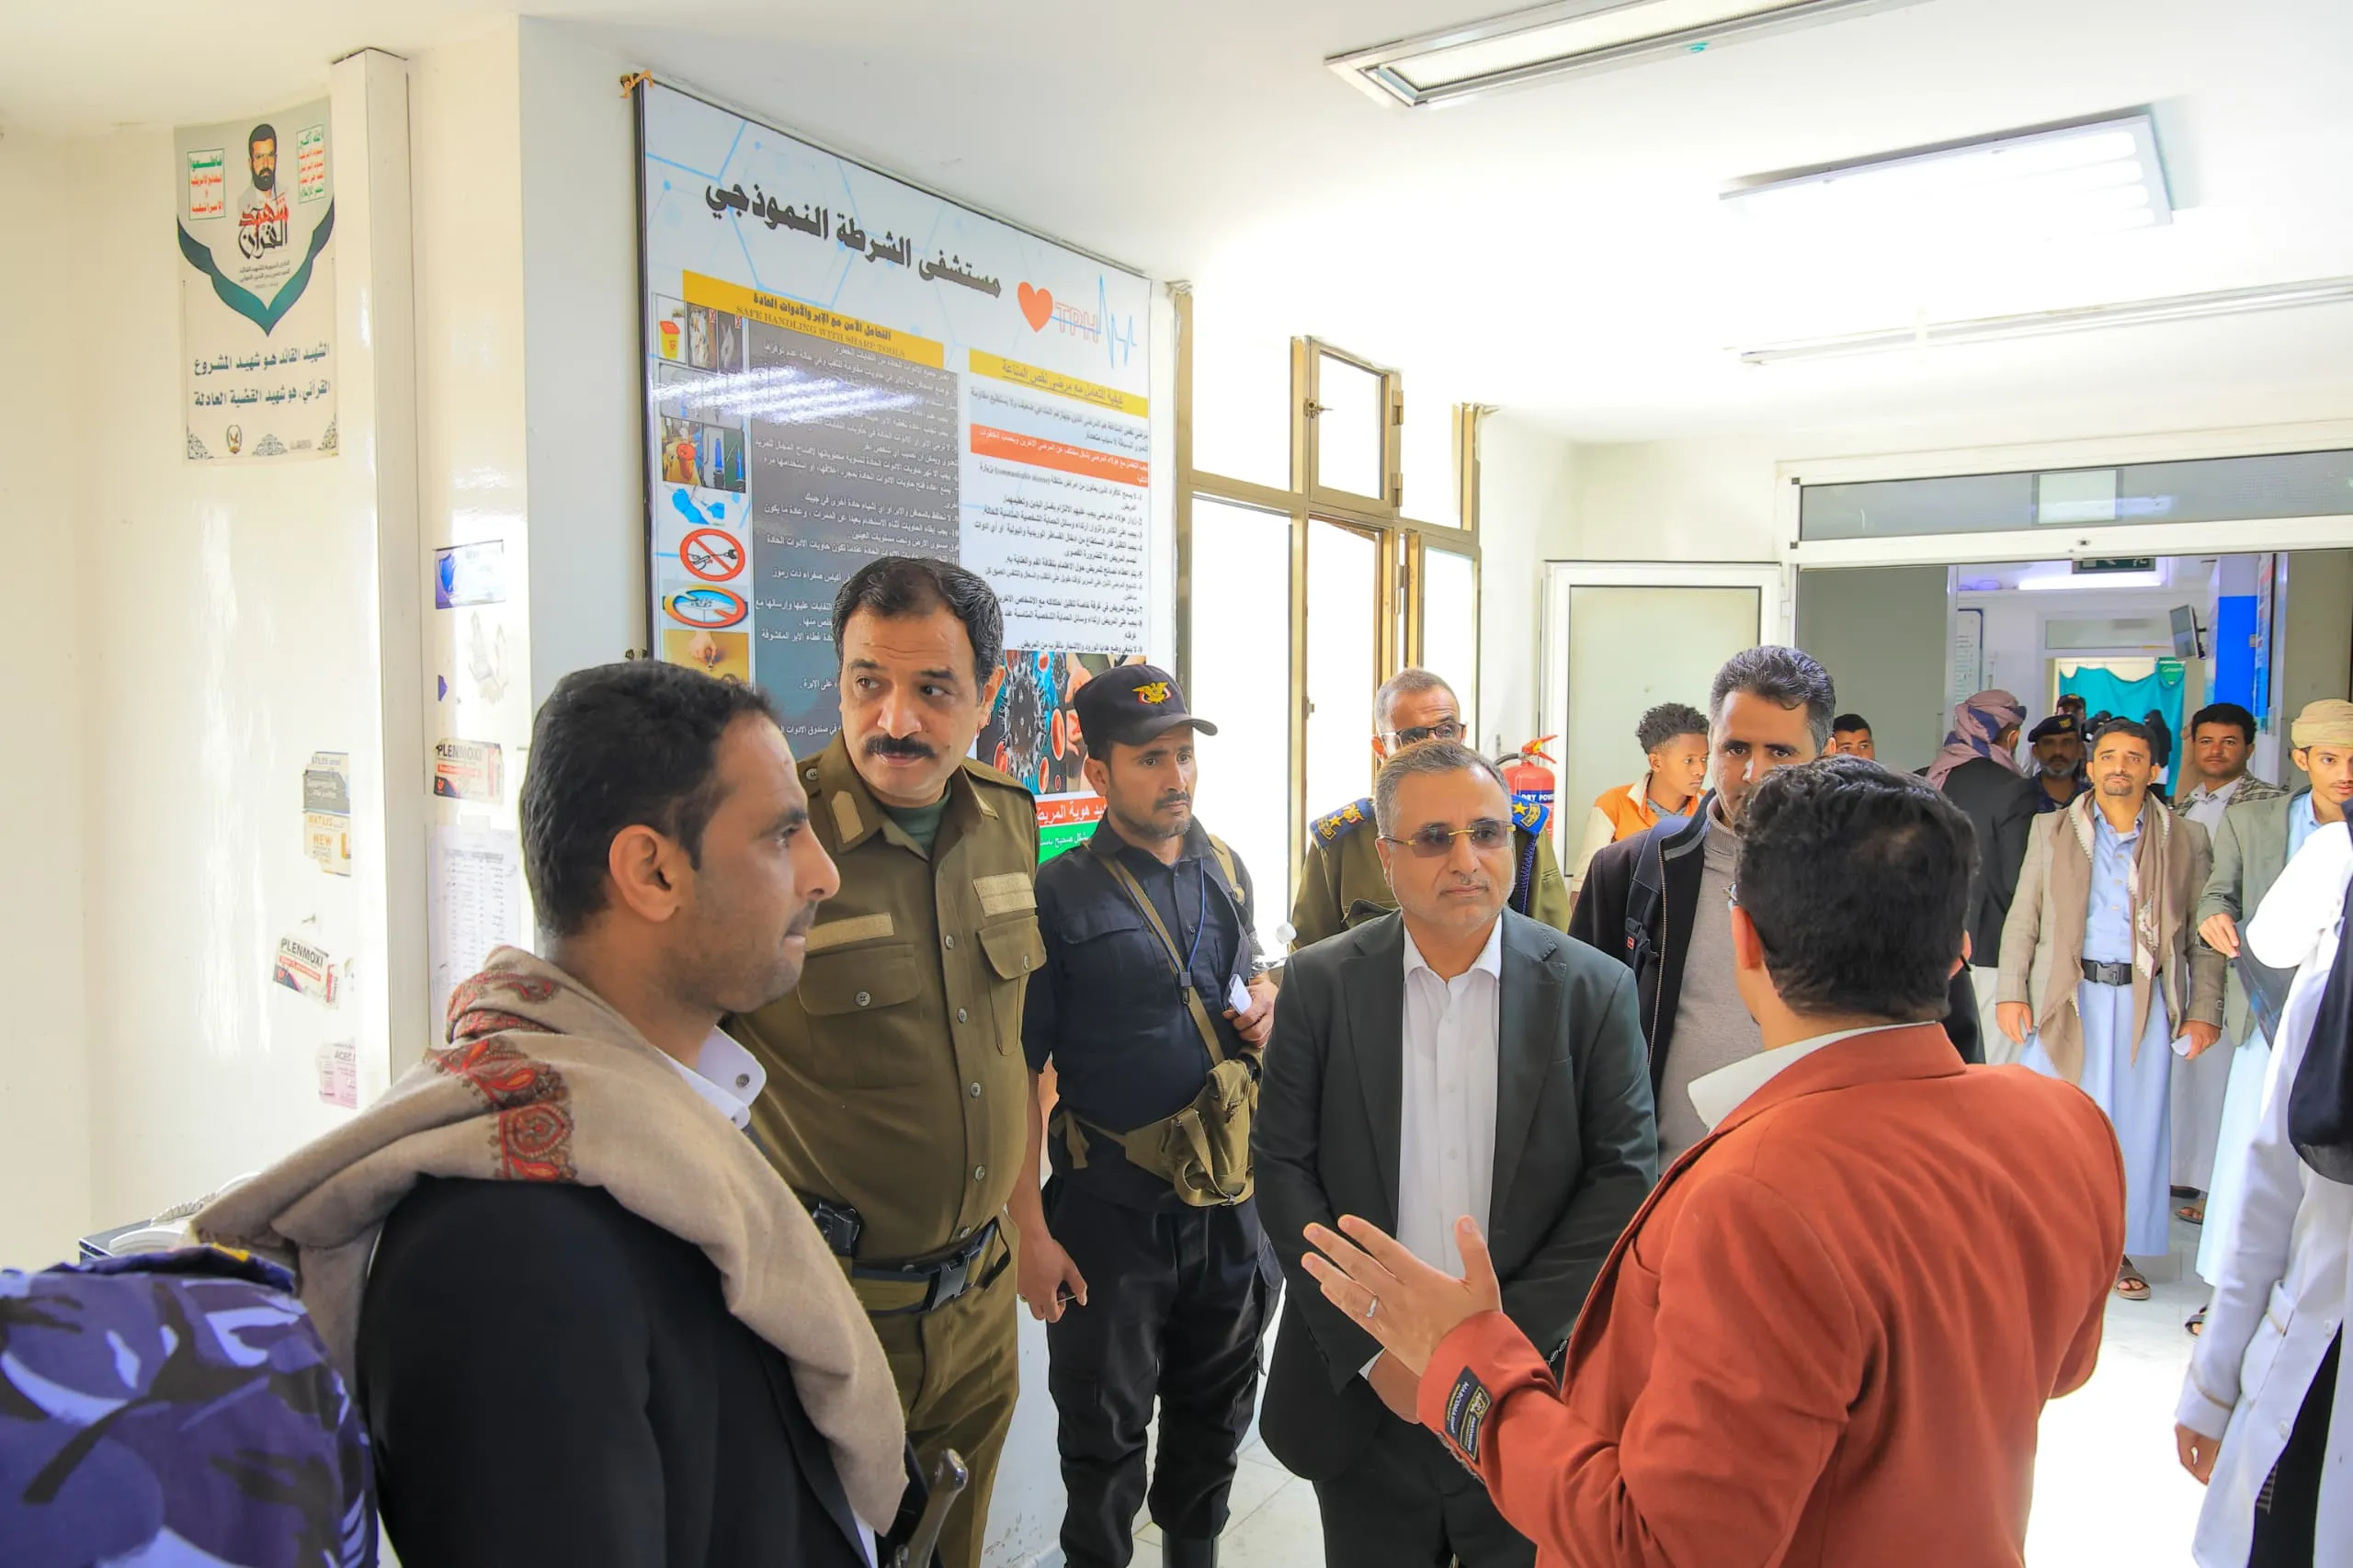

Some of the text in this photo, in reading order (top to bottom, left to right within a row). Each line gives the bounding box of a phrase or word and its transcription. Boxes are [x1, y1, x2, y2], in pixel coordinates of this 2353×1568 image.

[705, 183, 1002, 298] مستشفى الشرطة النموذجي
[736, 306, 762, 319] SAFE
[765, 313, 815, 333] HANDLING
[818, 328, 843, 341] WITH
[845, 335, 875, 348] SHARP
[1055, 301, 1099, 344] TPH
[194, 342, 329, 376] الشهيد القائد هو شهيد المشروع
[194, 392, 227, 406] العادلة
[231, 389, 262, 408] القضية
[266, 384, 286, 404] شهيد
[288, 387, 297, 403] هو
[437, 744, 483, 762] PLENMOXI
[1069, 800, 1089, 822] هوية
[313, 832, 333, 846] NEW
[280, 937, 324, 969] PLENMOXI
